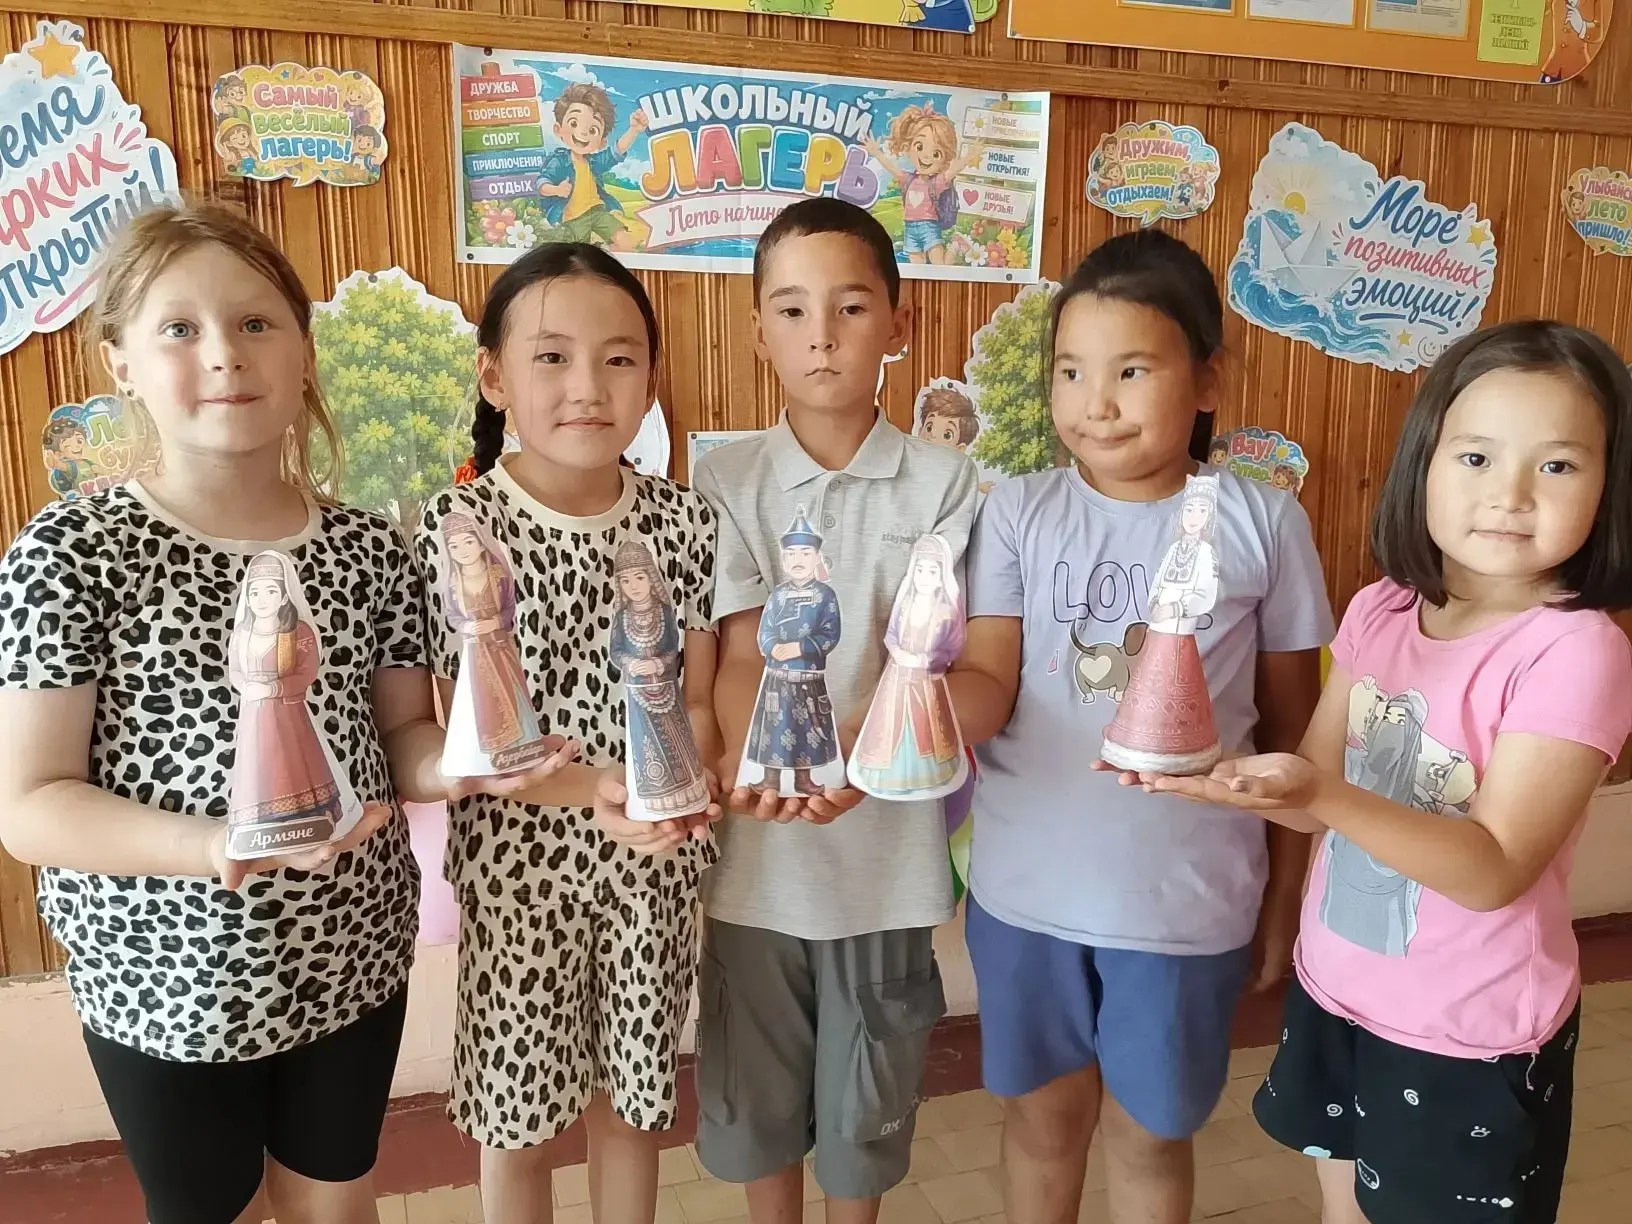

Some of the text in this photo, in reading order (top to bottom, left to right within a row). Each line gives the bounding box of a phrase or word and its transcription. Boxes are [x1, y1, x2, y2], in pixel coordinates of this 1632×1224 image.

[253, 83, 338, 110] Самый
[470, 81, 519, 97] ДРУЖБА
[252, 107, 350, 137] весёлый
[467, 106, 531, 121] ТВОРЧЕСТВО
[640, 83, 873, 141] ШКОЛЬНЫЙ
[992, 115, 1018, 128] НОВЫЕ
[0, 85, 106, 172] емя
[482, 132, 521, 146] СПОРТ
[260, 136, 353, 163] лагерь!
[988, 151, 1016, 164] НОВЫЕ
[1120, 138, 1192, 160] Дружим,
[472, 155, 544, 172] ПРИКЛЮЧЕНИЯ
[641, 125, 880, 208] ЛАГЕРЬ
[986, 163, 1031, 177] ОТКРЫТИЯ!
[1125, 162, 1179, 181] играем,
[488, 180, 534, 195] ОТДЫХ
[984, 191, 1011, 204] НОВЫЕ
[1107, 185, 1176, 206] отдыхаем!
[1579, 174, 1632, 201] Улыбайс
[982, 202, 1014, 215] ДРУЗЬЯ!
[1349, 180, 1462, 248] Море
[1587, 202, 1627, 222] лето
[665, 205, 721, 237] Лето
[1575, 221, 1630, 245] пришло!
[1343, 235, 1488, 290] позитивных
[1344, 276, 1481, 329] эмоций!
[1232, 433, 1276, 462] Вау!
[249, 826, 315, 850] Армяне
